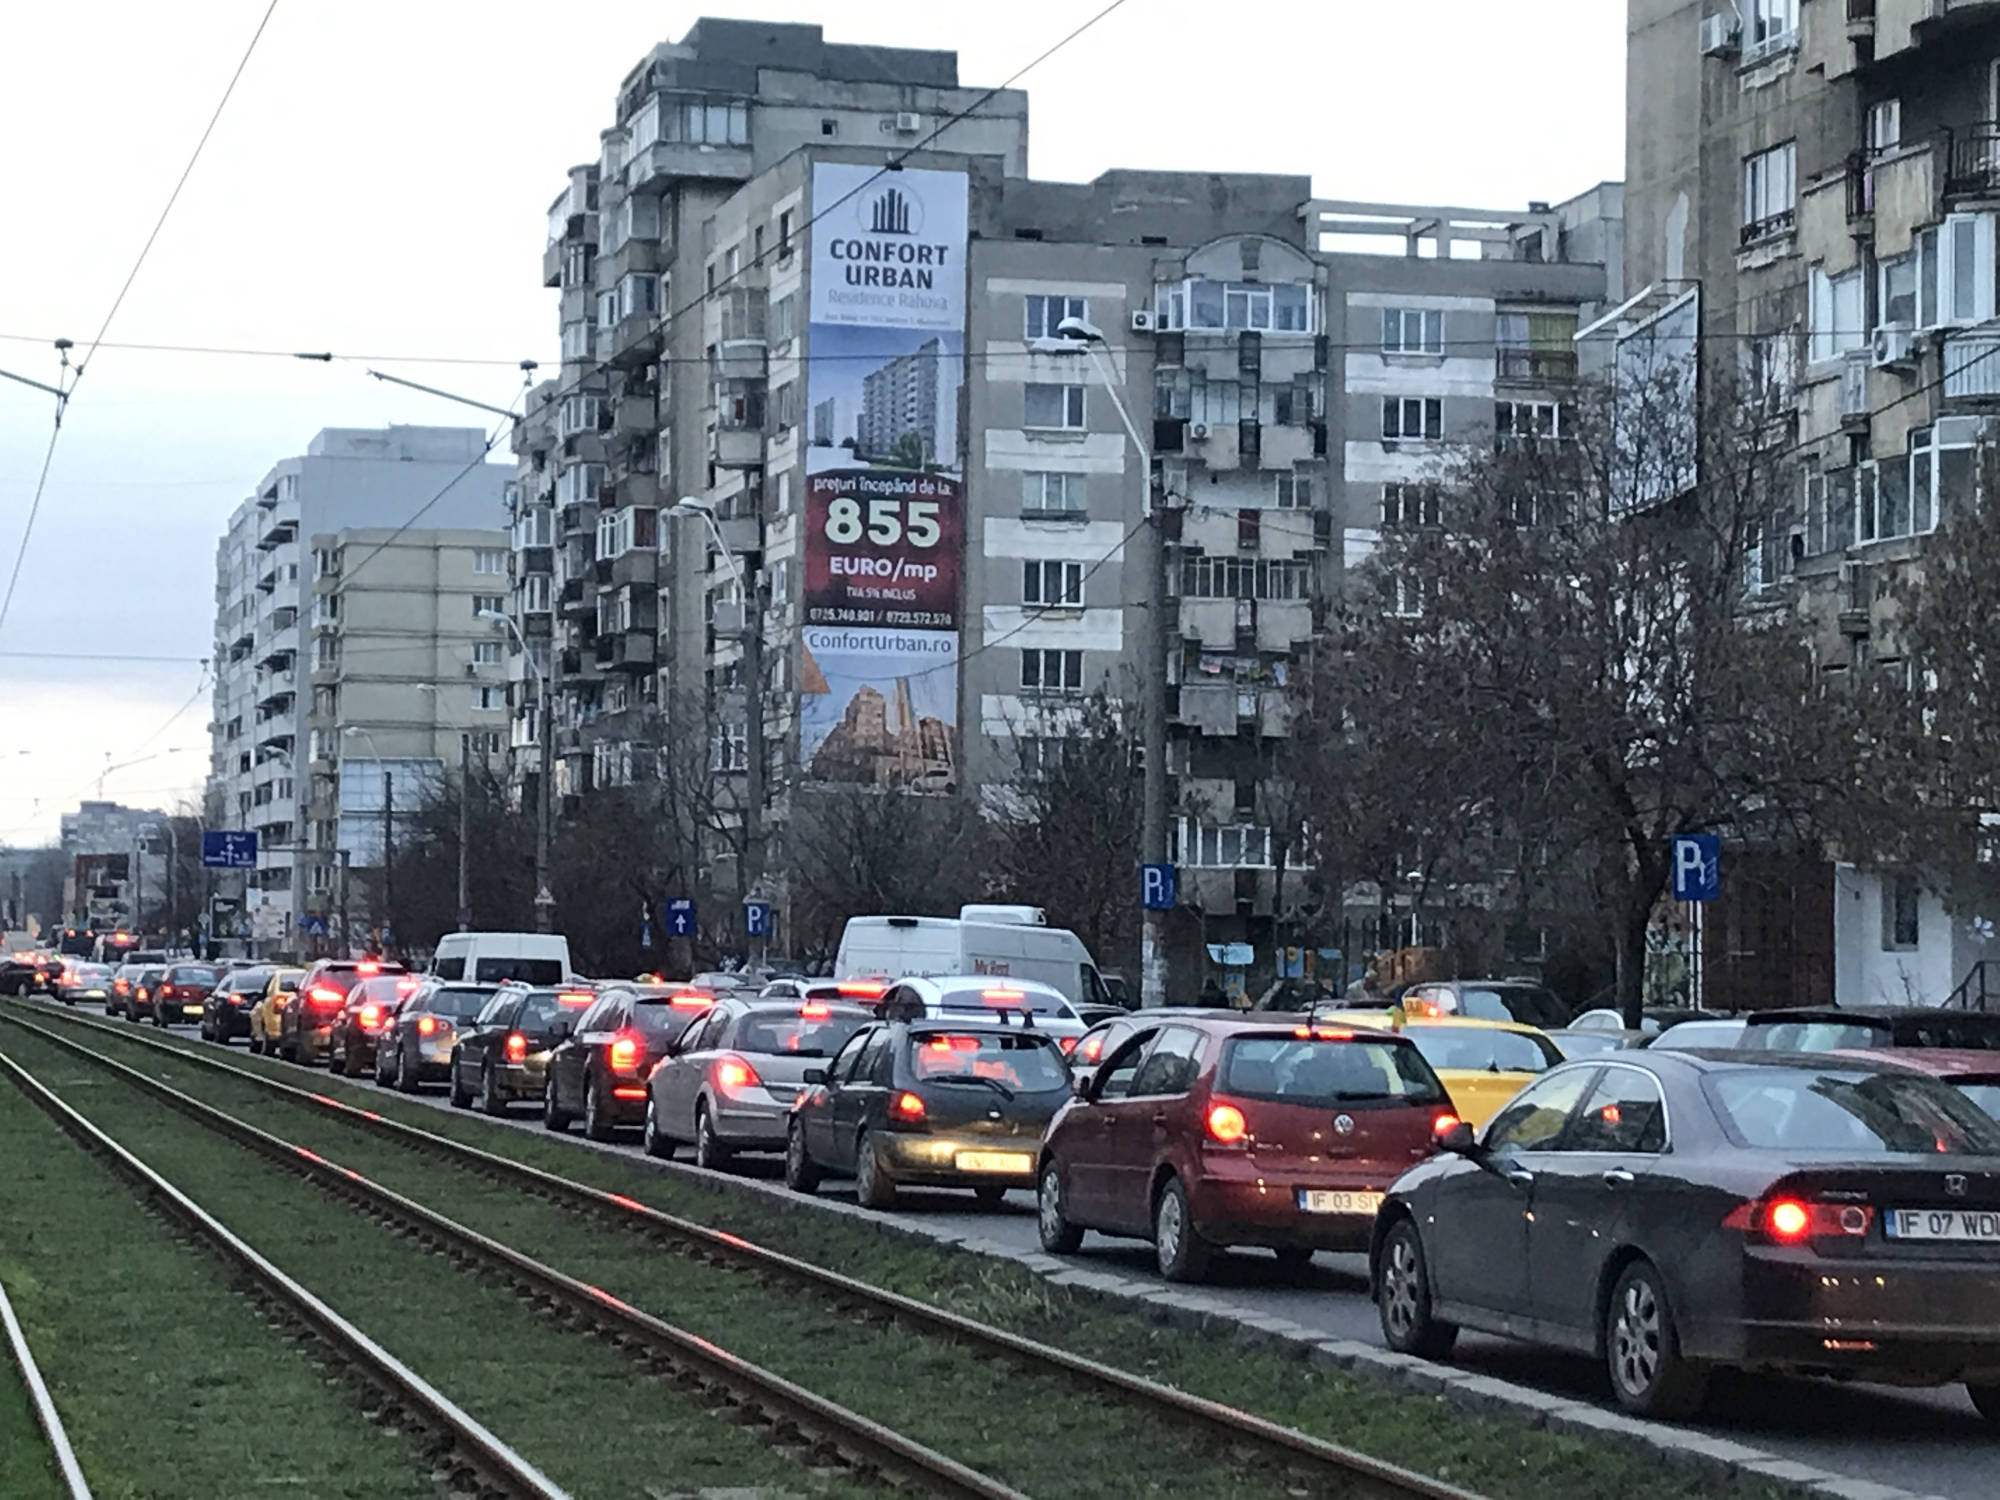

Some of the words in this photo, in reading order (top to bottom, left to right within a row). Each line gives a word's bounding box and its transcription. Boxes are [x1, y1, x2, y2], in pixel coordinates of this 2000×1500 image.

[830, 238, 949, 266] CONFORT
[845, 264, 933, 290] URBAN
[828, 288, 896, 308] Residence
[919, 480, 935, 495] de
[825, 497, 941, 548] 855
[830, 556, 938, 583] EURO/mp
[846, 586, 864, 598] TVA
[882, 588, 917, 600] INCLUS
[809, 633, 951, 653] ConfortUrban.ro
[1677, 840, 1701, 892] P
[1144, 868, 1161, 904] P
[748, 905, 762, 932] P
[1312, 1193, 1326, 1207] IF
[1333, 1193, 1351, 1209] 03
[1899, 1212, 1920, 1235] IF
[1928, 1213, 1953, 1235] 07
